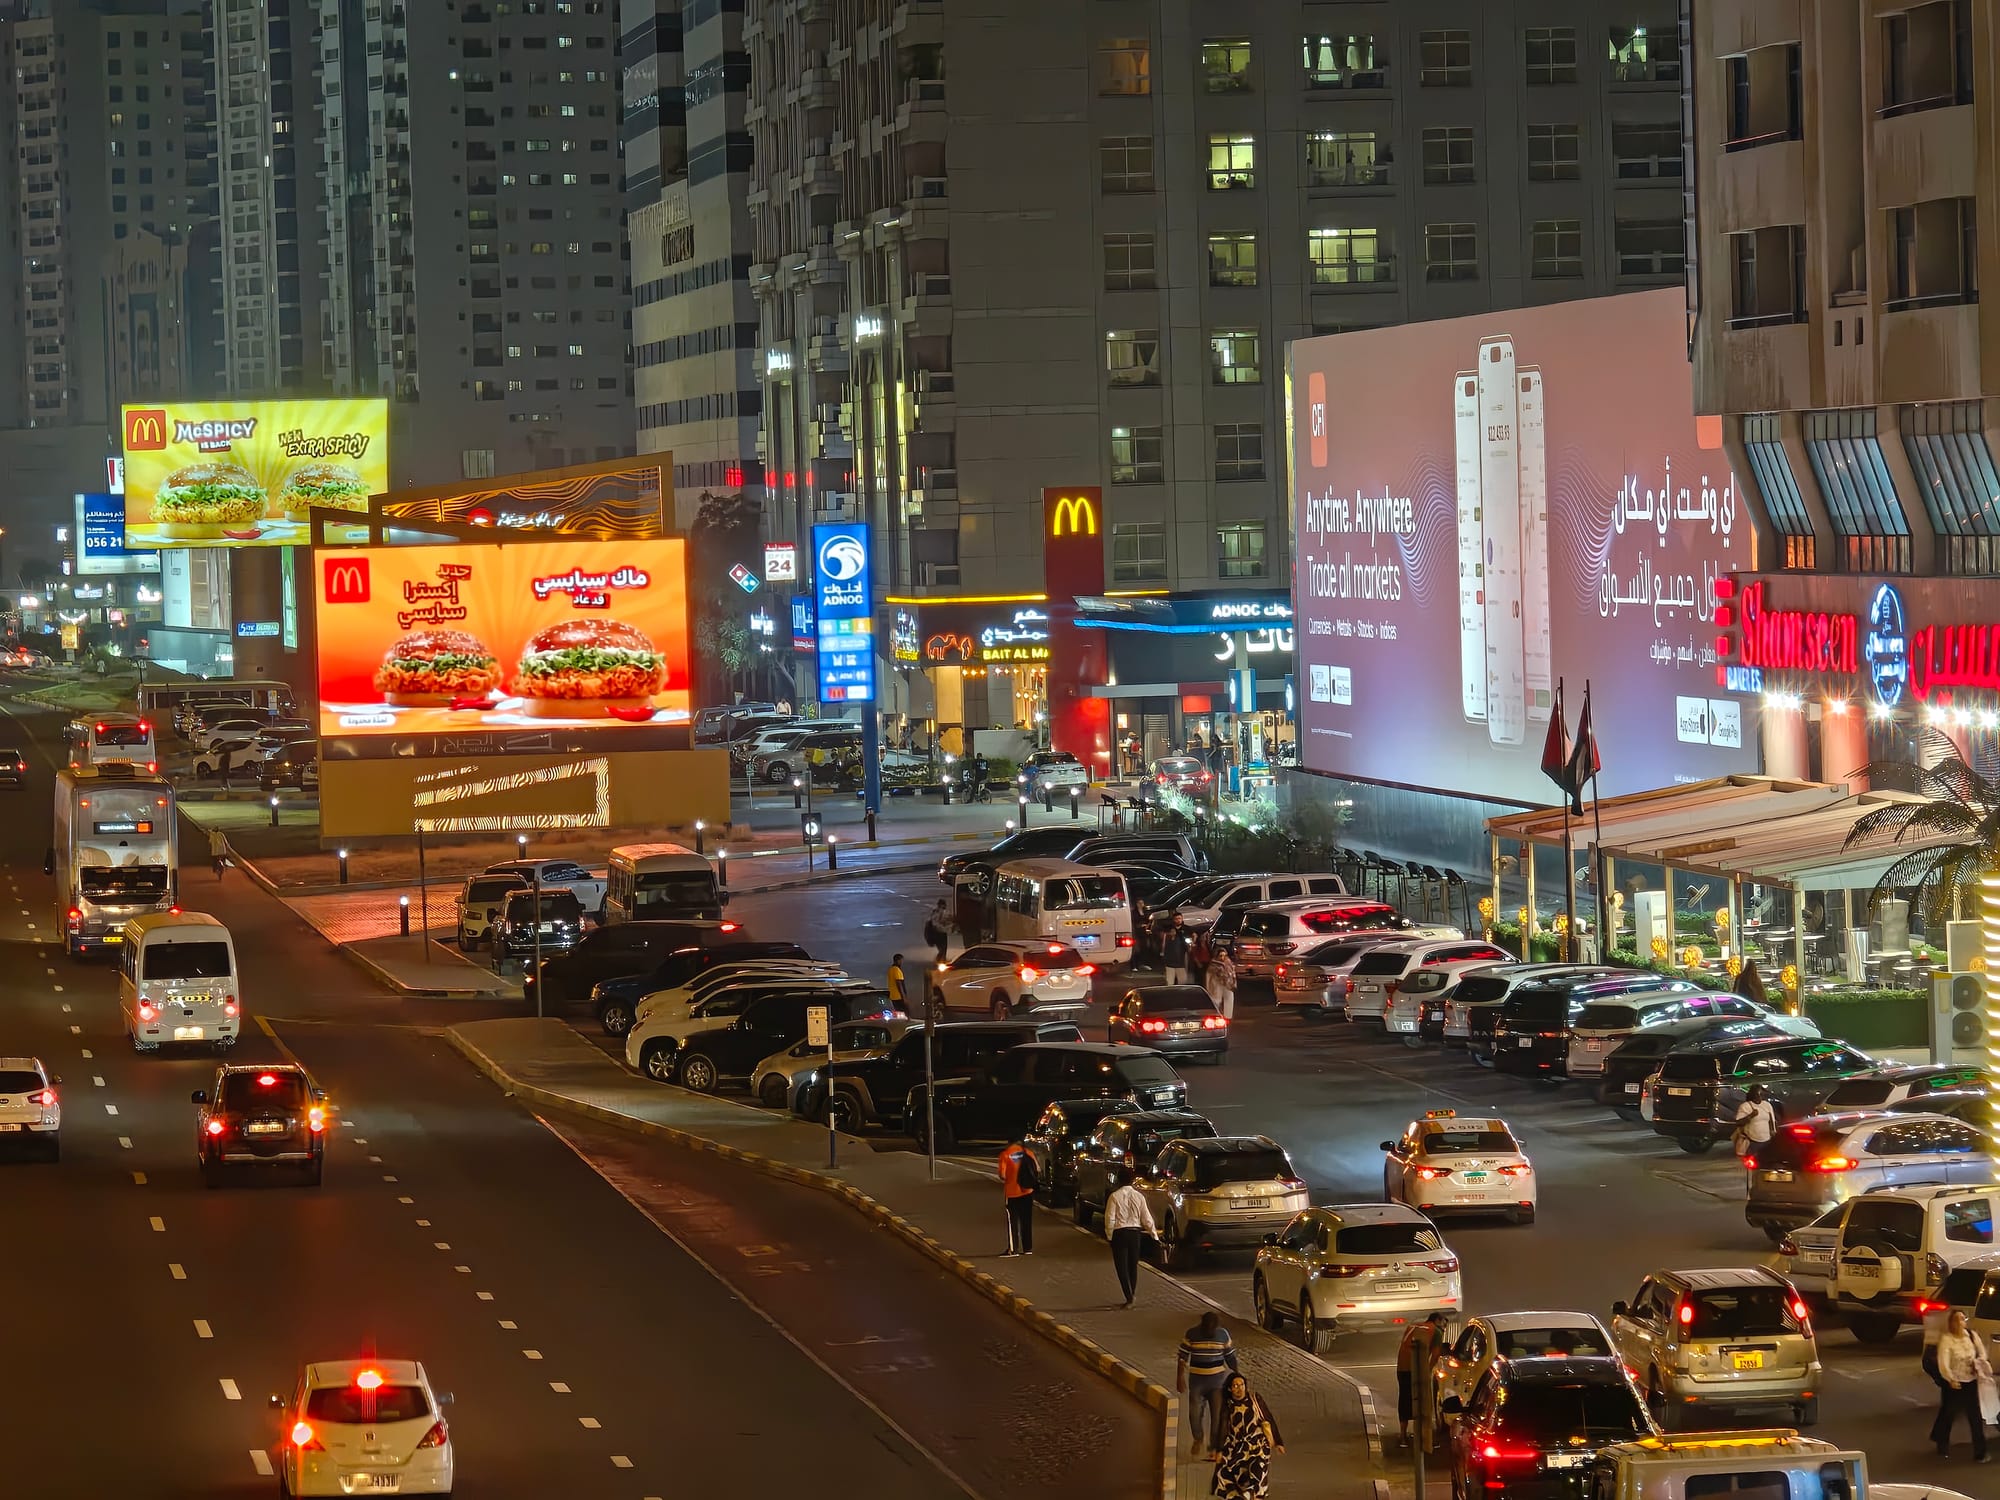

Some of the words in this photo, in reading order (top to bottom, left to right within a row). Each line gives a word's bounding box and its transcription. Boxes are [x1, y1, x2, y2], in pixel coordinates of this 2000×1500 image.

[1312, 402, 1325, 437] CFI
[1306, 484, 1353, 547] Anytime.
[1355, 485, 1416, 548] Anywhere.
[86, 537, 107, 548] 056
[768, 560, 792, 573] 24
[534, 572, 606, 597] سبايسي
[611, 569, 647, 587] ماك
[1306, 552, 1337, 598] Trade
[1339, 552, 1352, 598] all
[1353, 553, 1401, 601] markets
[823, 595, 863, 605] ADNOC
[399, 605, 465, 627] سبايسي
[1212, 604, 1261, 617] ADNOC
[983, 650, 1011, 660] BAIT
[1014, 648, 1028, 658] AL
